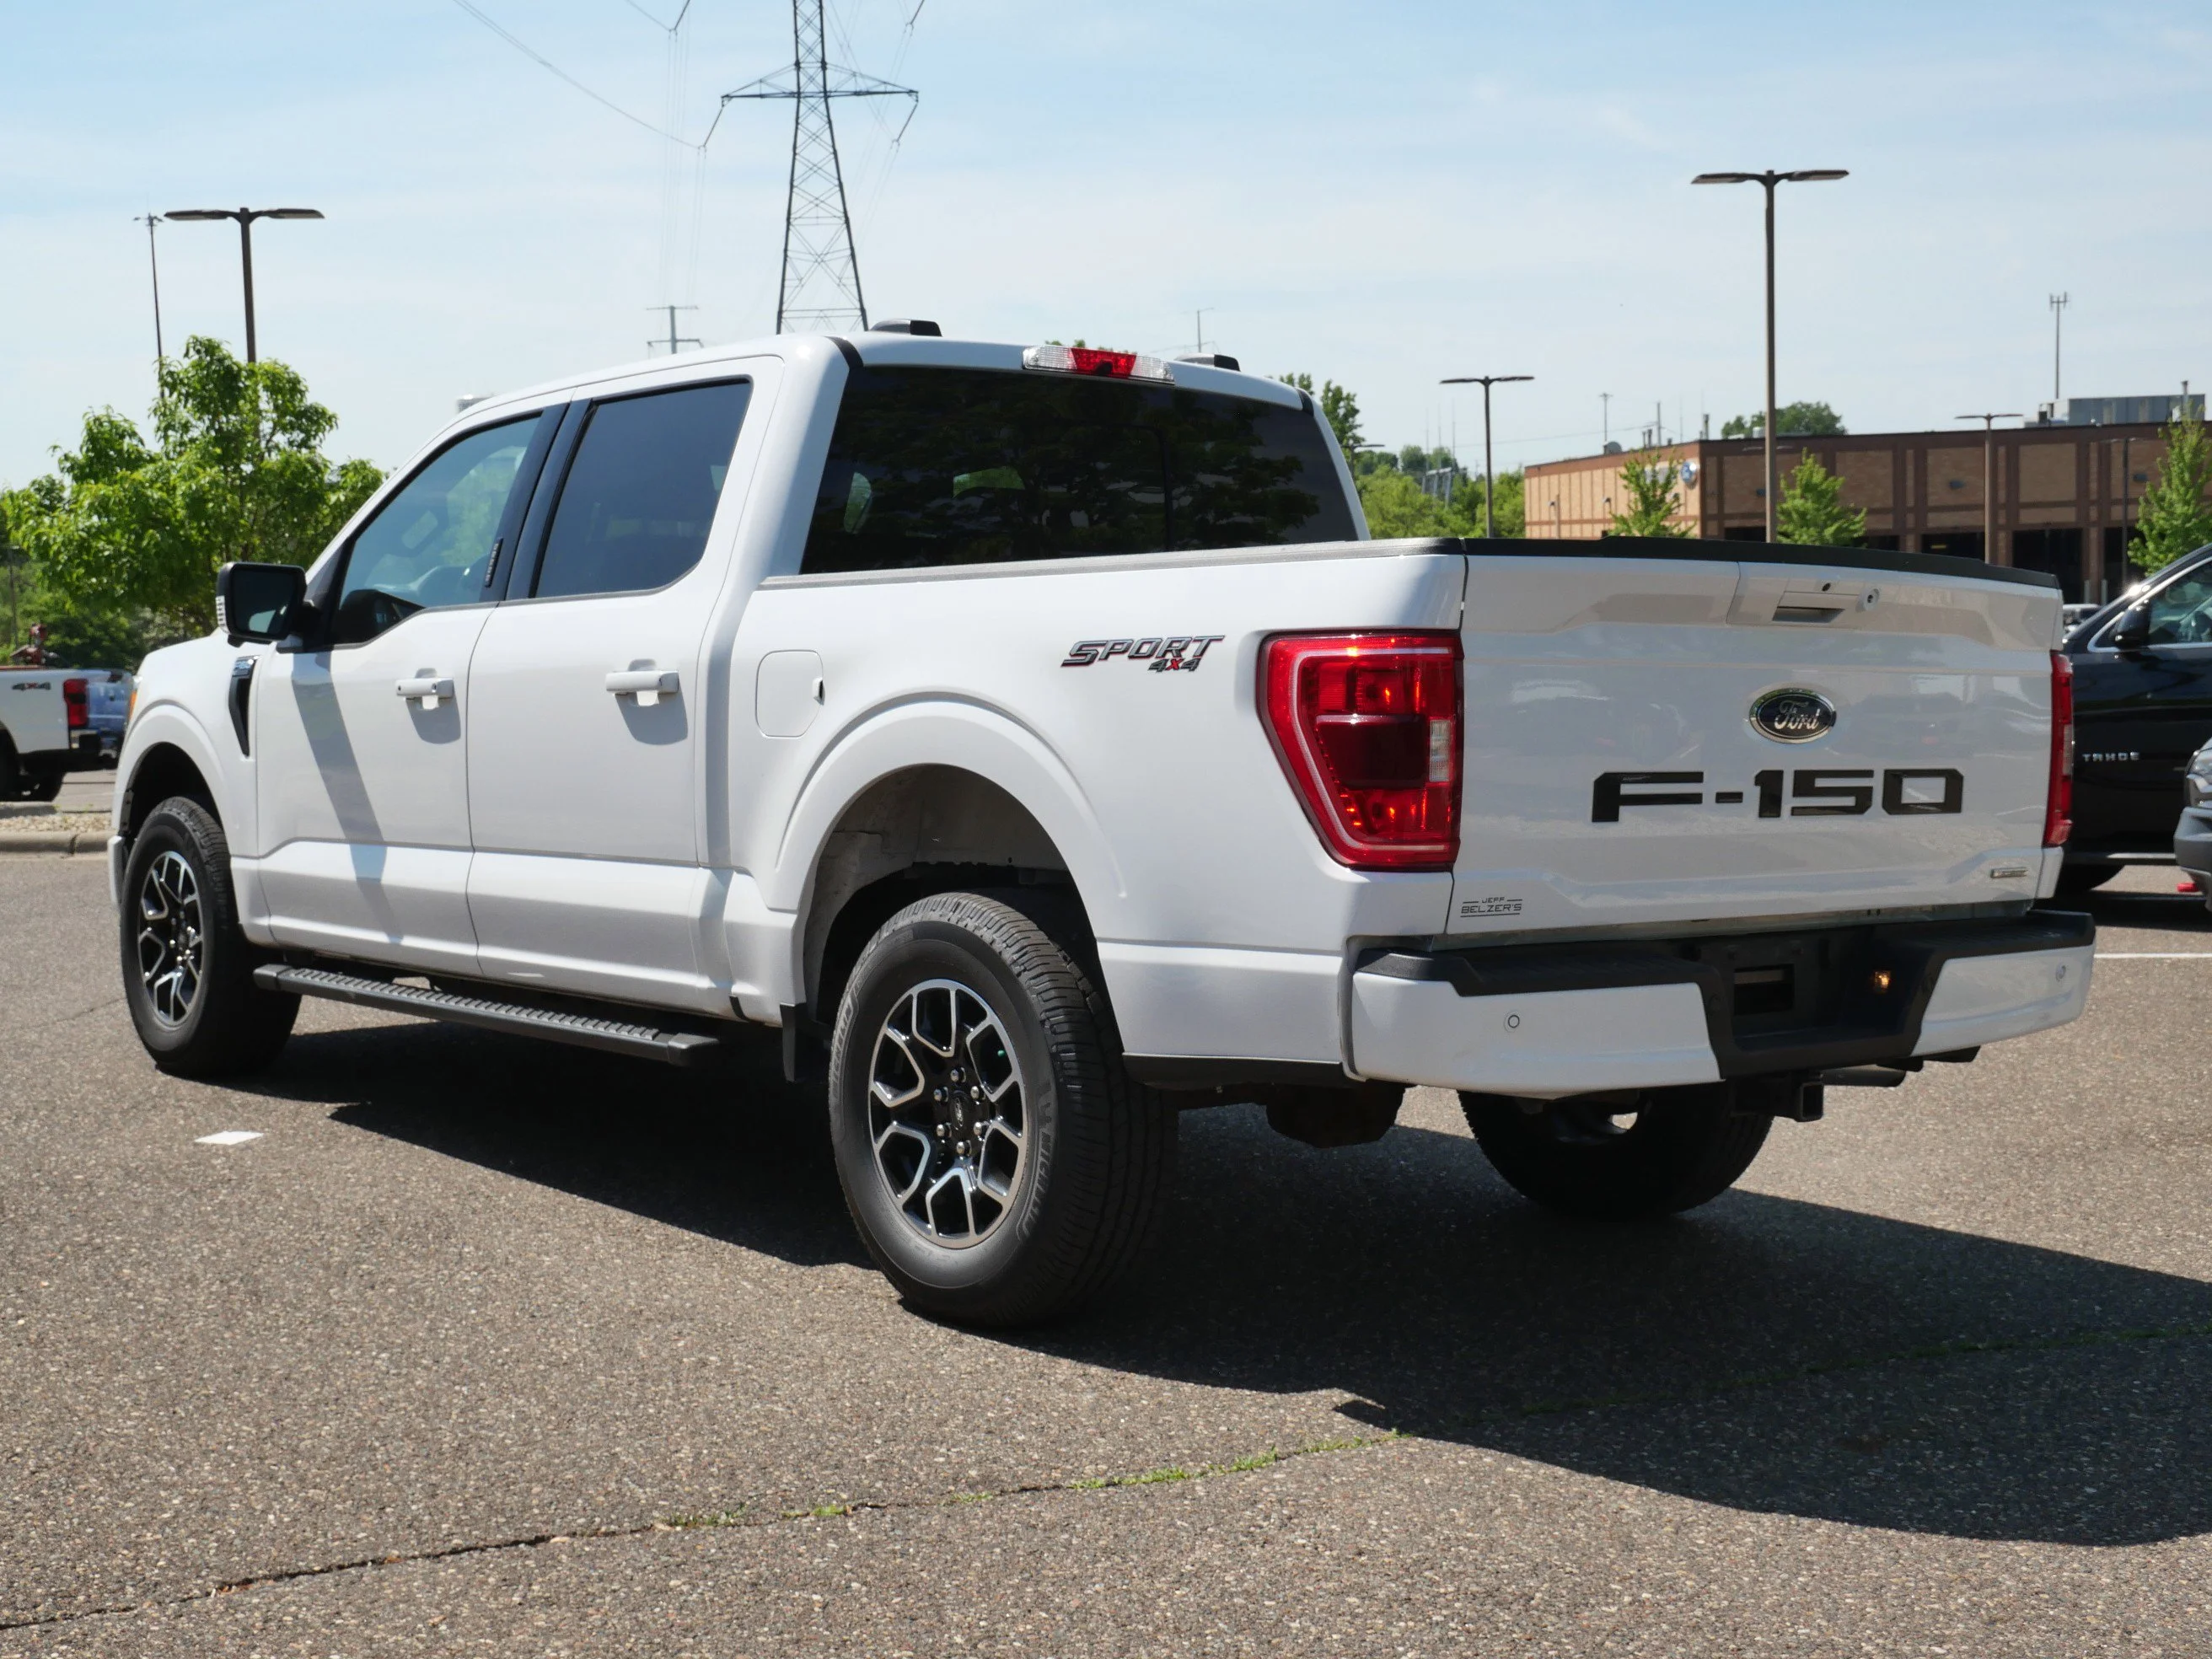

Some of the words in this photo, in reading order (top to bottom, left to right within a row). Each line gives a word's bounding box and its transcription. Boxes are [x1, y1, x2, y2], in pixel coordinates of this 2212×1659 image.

[1060, 635, 1225, 668] SPORT
[1774, 700, 1821, 730] Ford
[2082, 751, 2140, 762] TAHOE
[1592, 768, 1964, 823] F-150
[1460, 903, 1522, 914] BELZER'S
